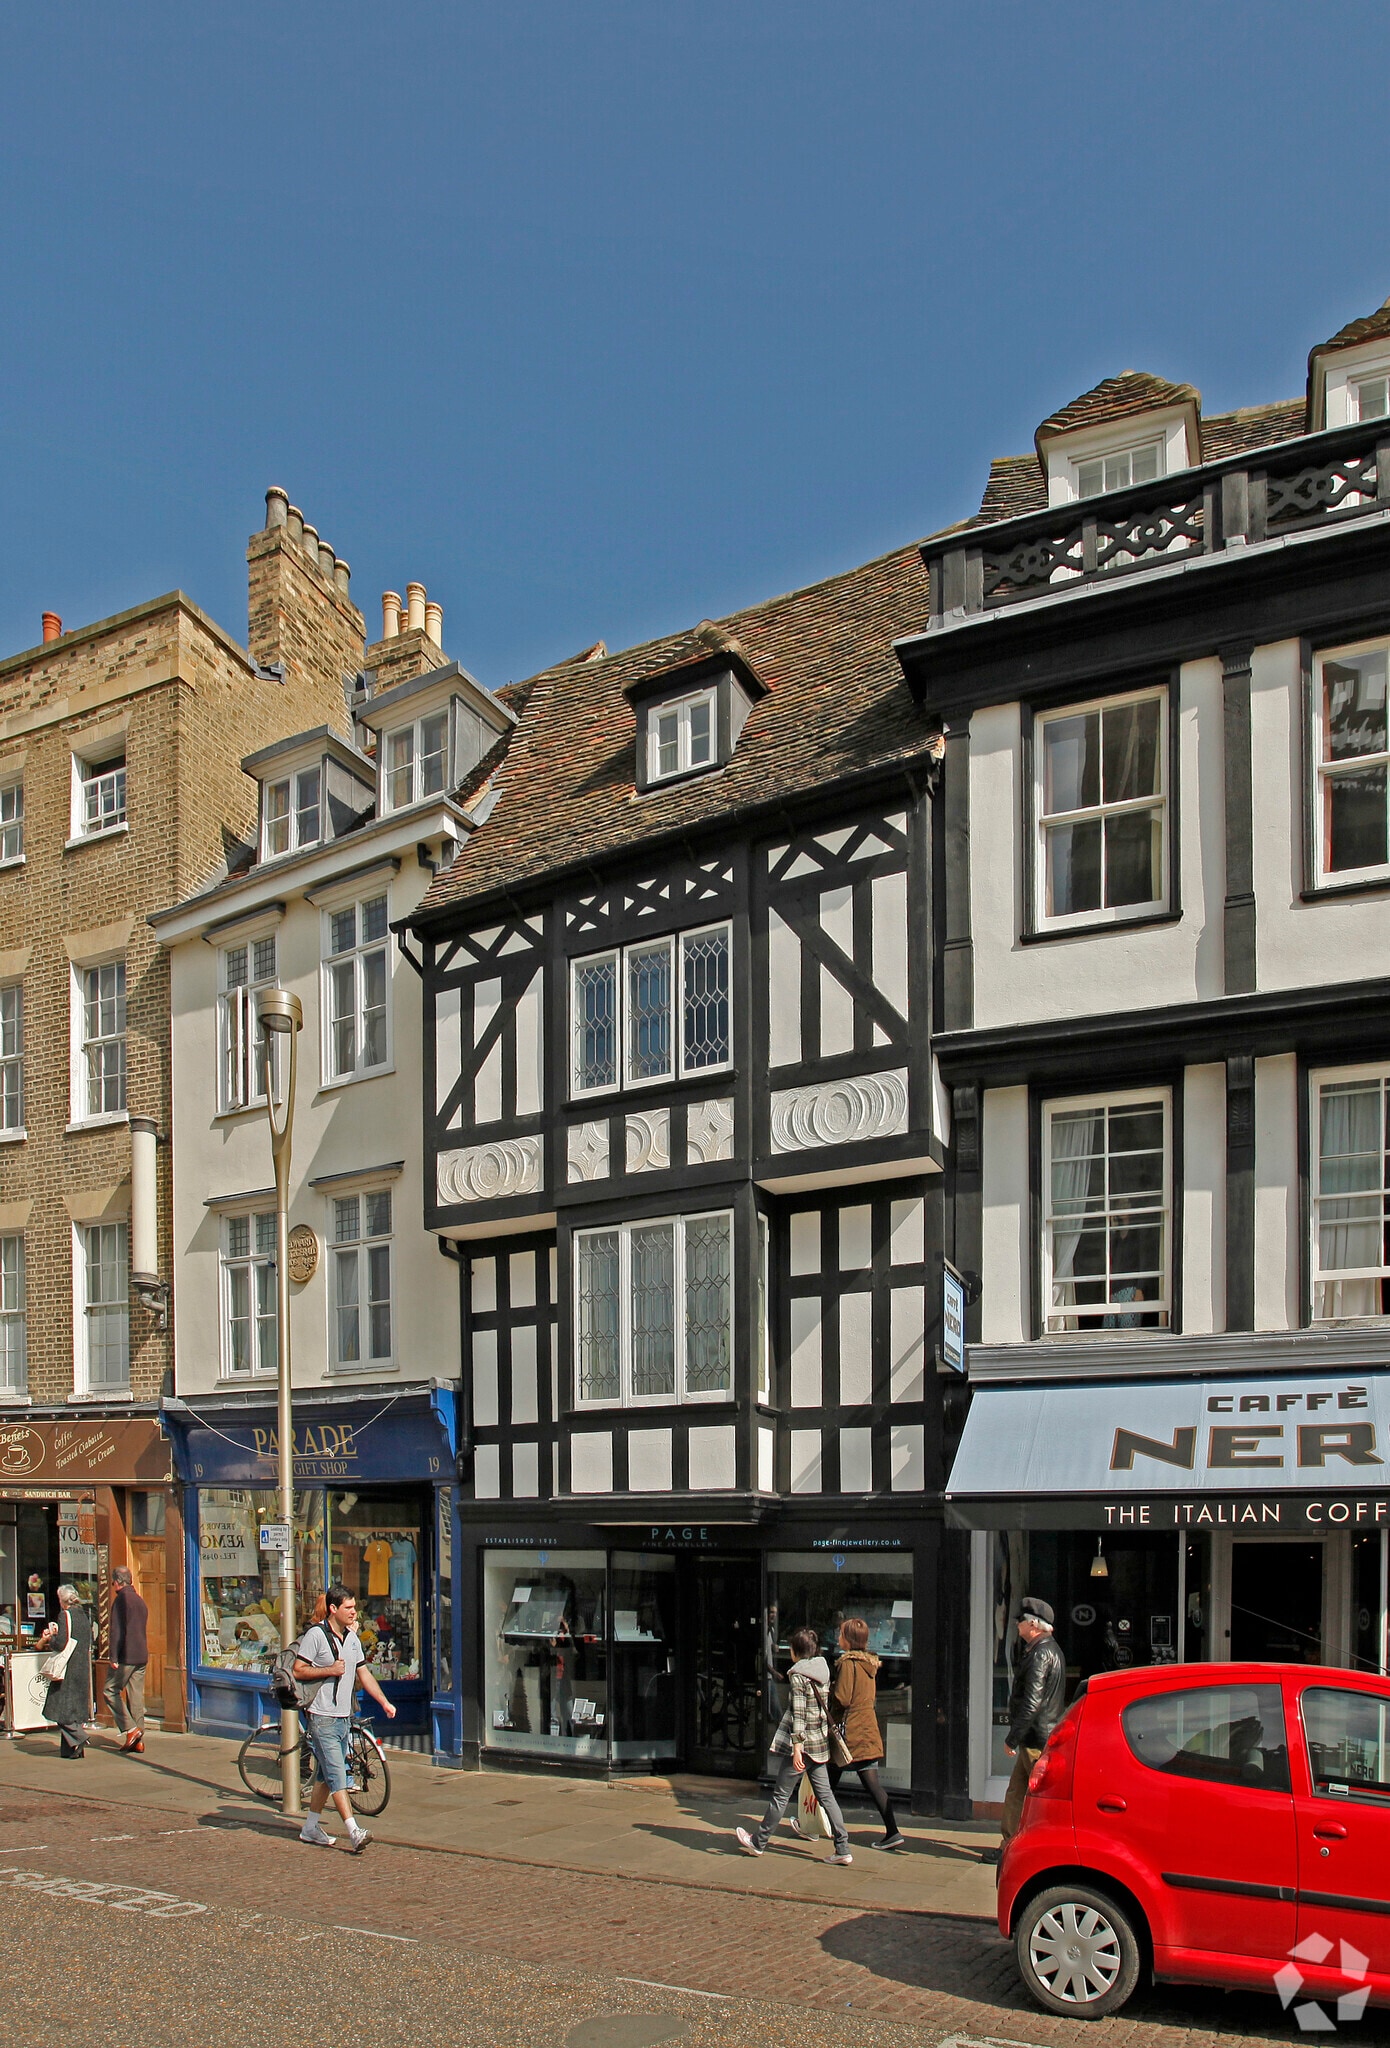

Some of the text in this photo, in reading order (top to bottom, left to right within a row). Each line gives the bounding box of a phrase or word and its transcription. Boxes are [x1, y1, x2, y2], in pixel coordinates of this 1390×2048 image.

[1207, 1386, 1368, 1413] CAFFÈ
[54, 1430, 73, 1450] Coffee
[1109, 1422, 1390, 1471] NER
[56, 1431, 104, 1470] Toasted Ciabatta
[88, 1444, 116, 1469] Ice Cream
[193, 1463, 203, 1478] 19
[294, 1461, 318, 1475] GIFT
[320, 1461, 348, 1475] SHOP
[428, 1456, 440, 1473] 19
[24, 1490, 57, 1498] SANDWICH
[58, 1490, 71, 1498] BAR
[1104, 1502, 1387, 1524] THE ITALIAN COFF
[651, 1528, 708, 1540] PAGE
[812, 1538, 901, 1547] page-finejewellery.co.uk
